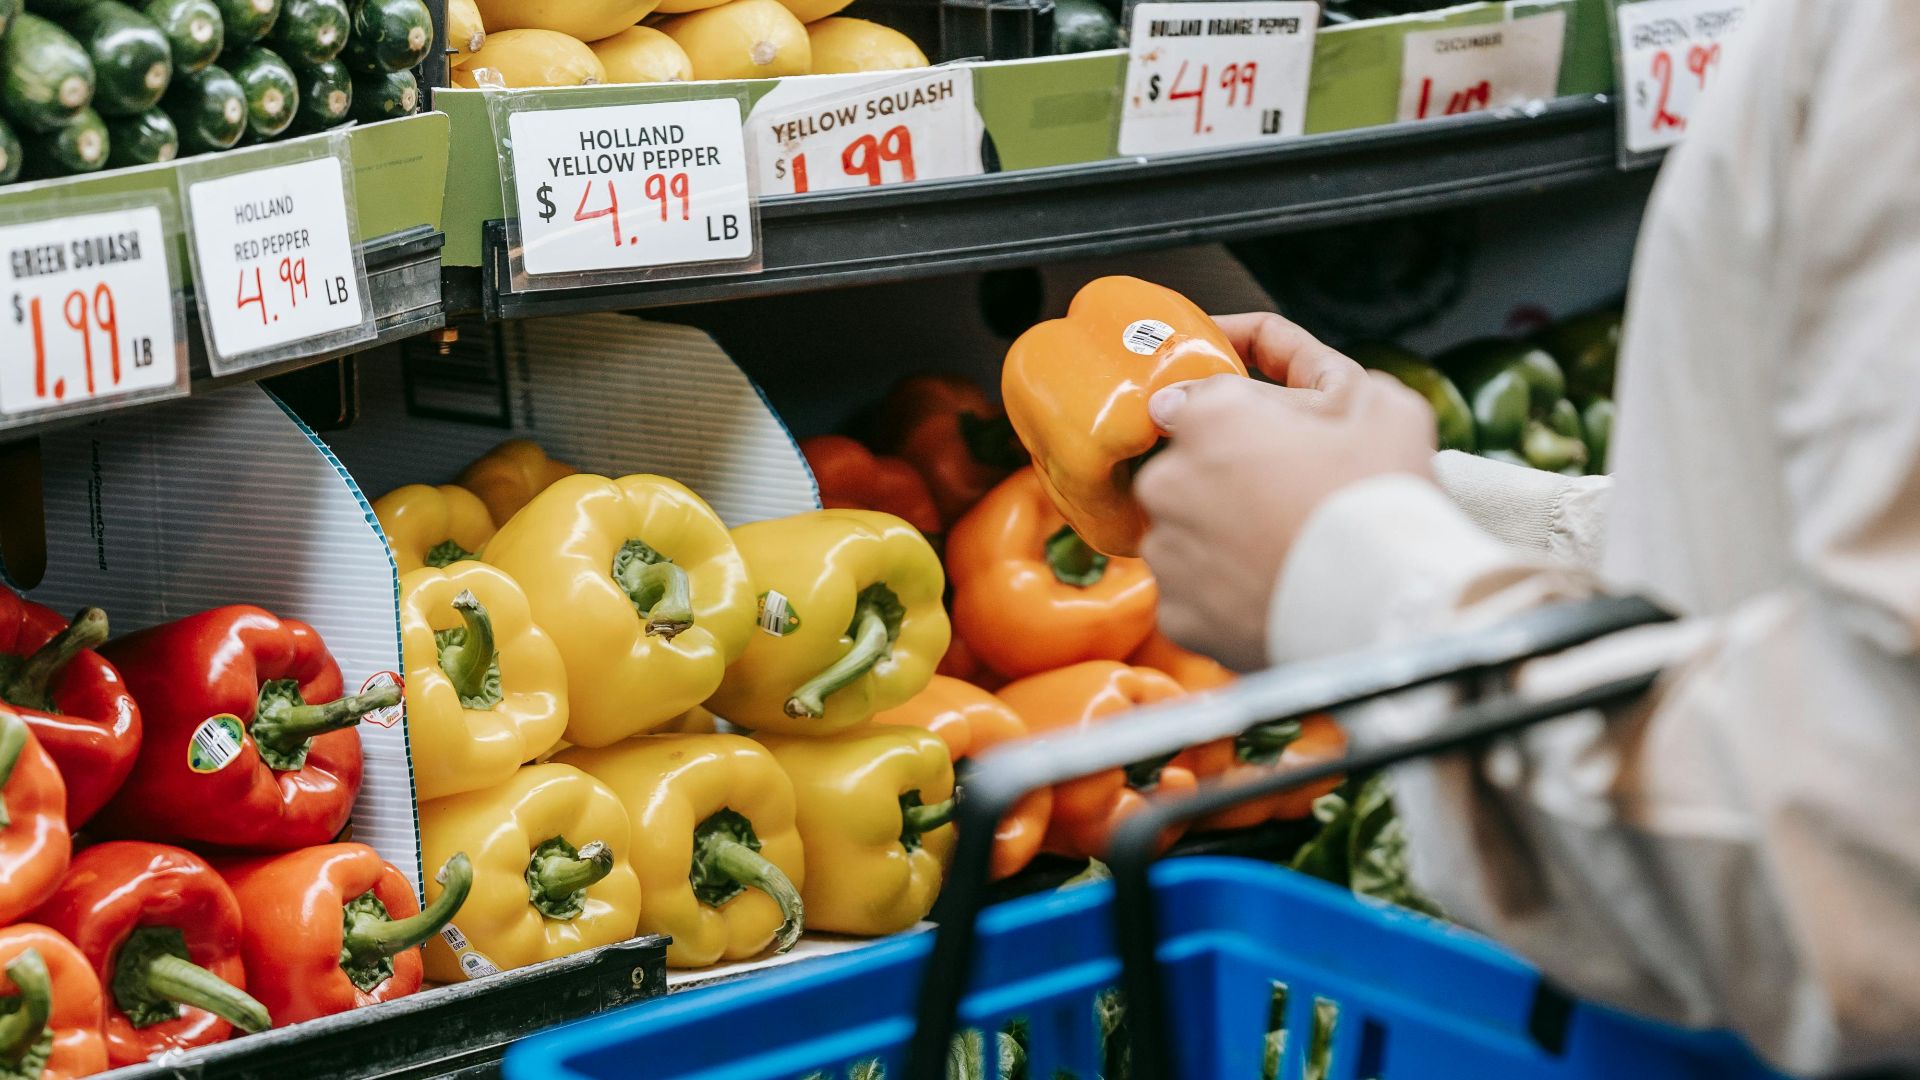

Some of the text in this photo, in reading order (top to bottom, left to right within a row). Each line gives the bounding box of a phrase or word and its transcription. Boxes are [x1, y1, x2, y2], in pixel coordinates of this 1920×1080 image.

[771, 79, 954, 144] YELLOW SQUASH
[1168, 59, 1258, 135] 4.99
[579, 124, 685, 151] HOLLAND
[1262, 109, 1282, 135] LB
[548, 145, 721, 178] YELLOW PEPPER
[234, 195, 294, 225] HOLLAND
[536, 172, 690, 247] $ 4.99
[706, 213, 740, 242] LB
[71, 230, 142, 269] SQUASH
[234, 228, 311, 262] RED PEPPER
[236, 256, 309, 326] 4.99
[325, 276, 349, 306] LB
[29, 281, 122, 400] 1.99
[133, 336, 153, 368] LB
